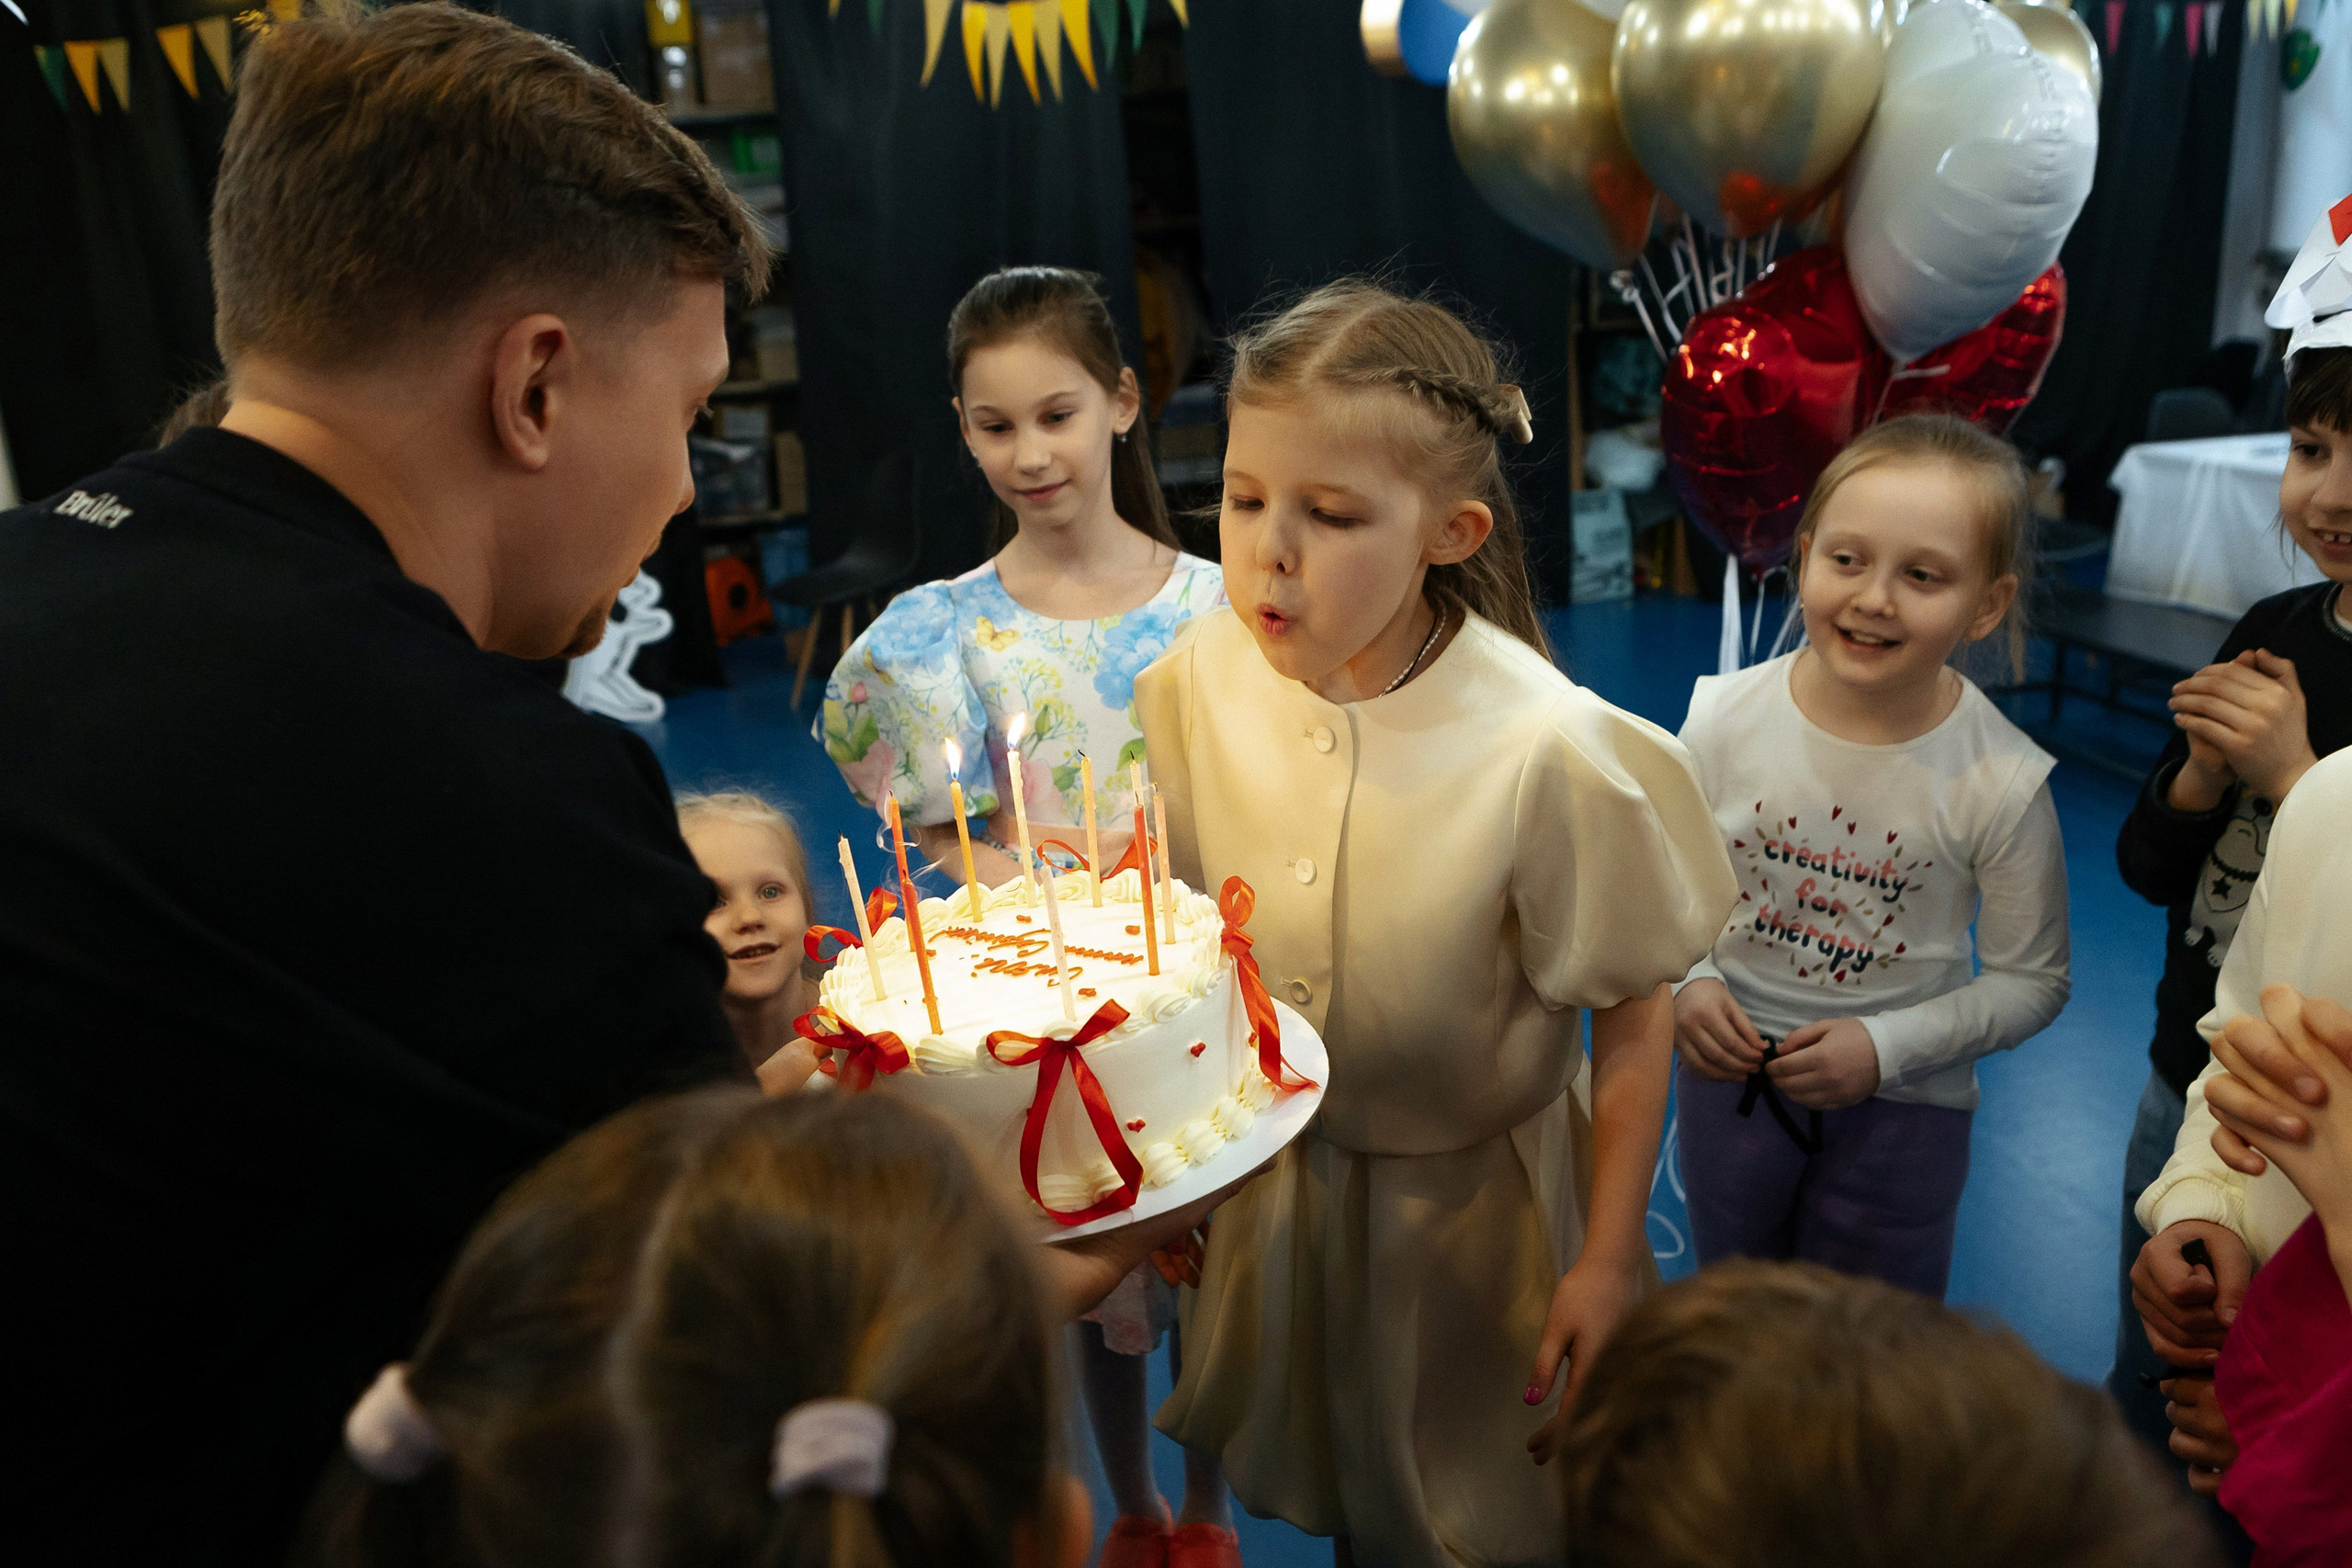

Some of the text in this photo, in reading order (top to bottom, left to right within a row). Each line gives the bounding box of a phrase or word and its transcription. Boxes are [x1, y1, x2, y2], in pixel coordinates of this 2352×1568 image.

[1764, 839, 1909, 903] creativity
[1794, 877, 1849, 917] for
[1754, 903, 1874, 973] therapy
